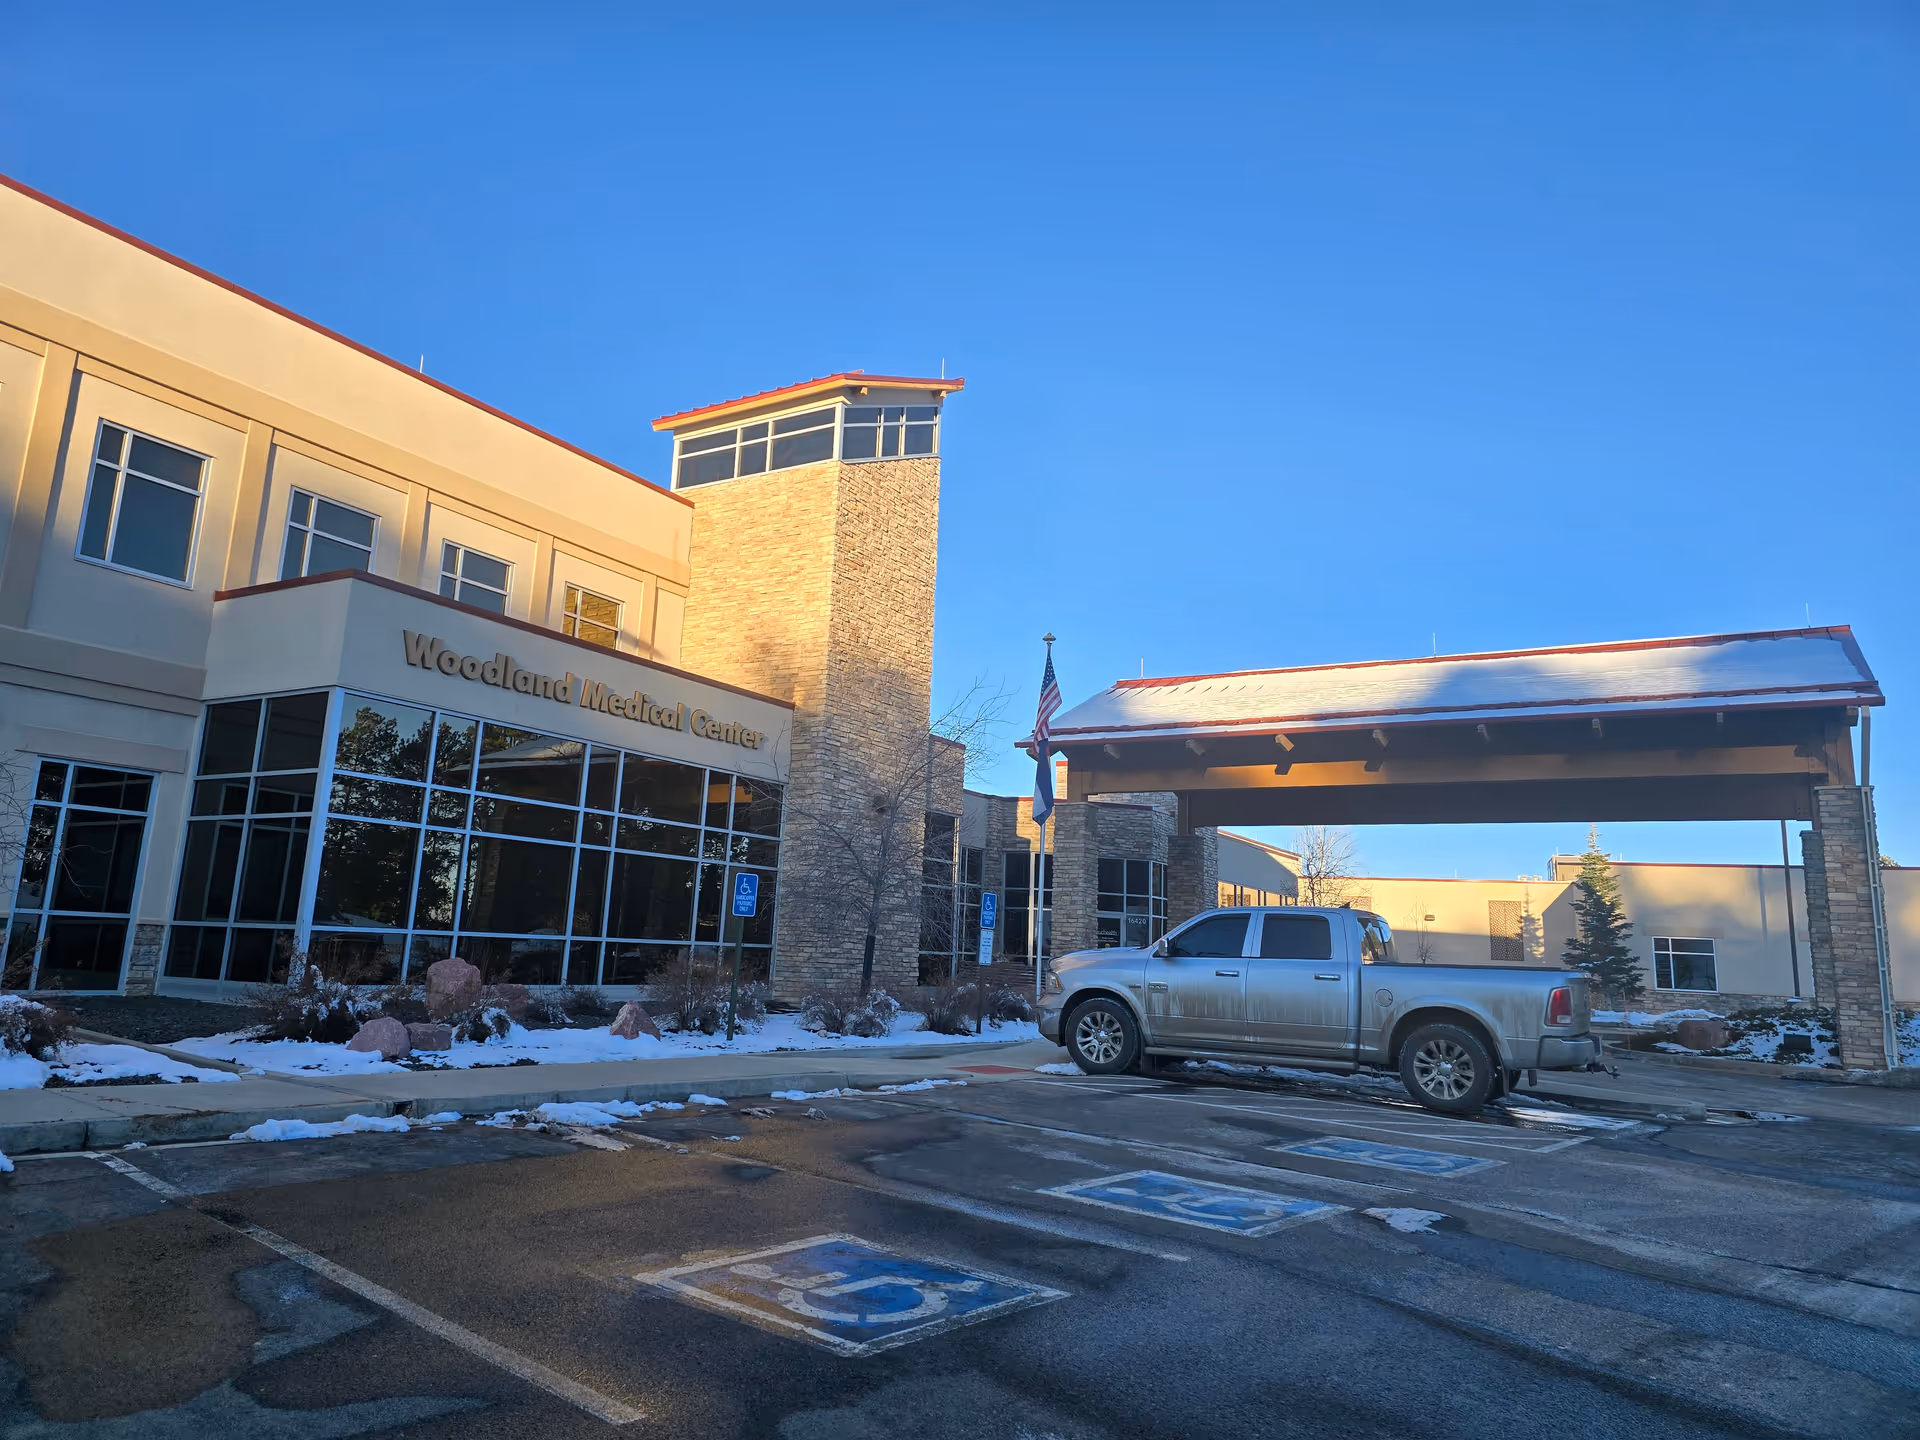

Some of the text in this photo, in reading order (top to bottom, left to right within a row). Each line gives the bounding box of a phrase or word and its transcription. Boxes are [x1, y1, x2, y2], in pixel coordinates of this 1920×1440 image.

[403, 629, 764, 750] Woodland Medical Center
